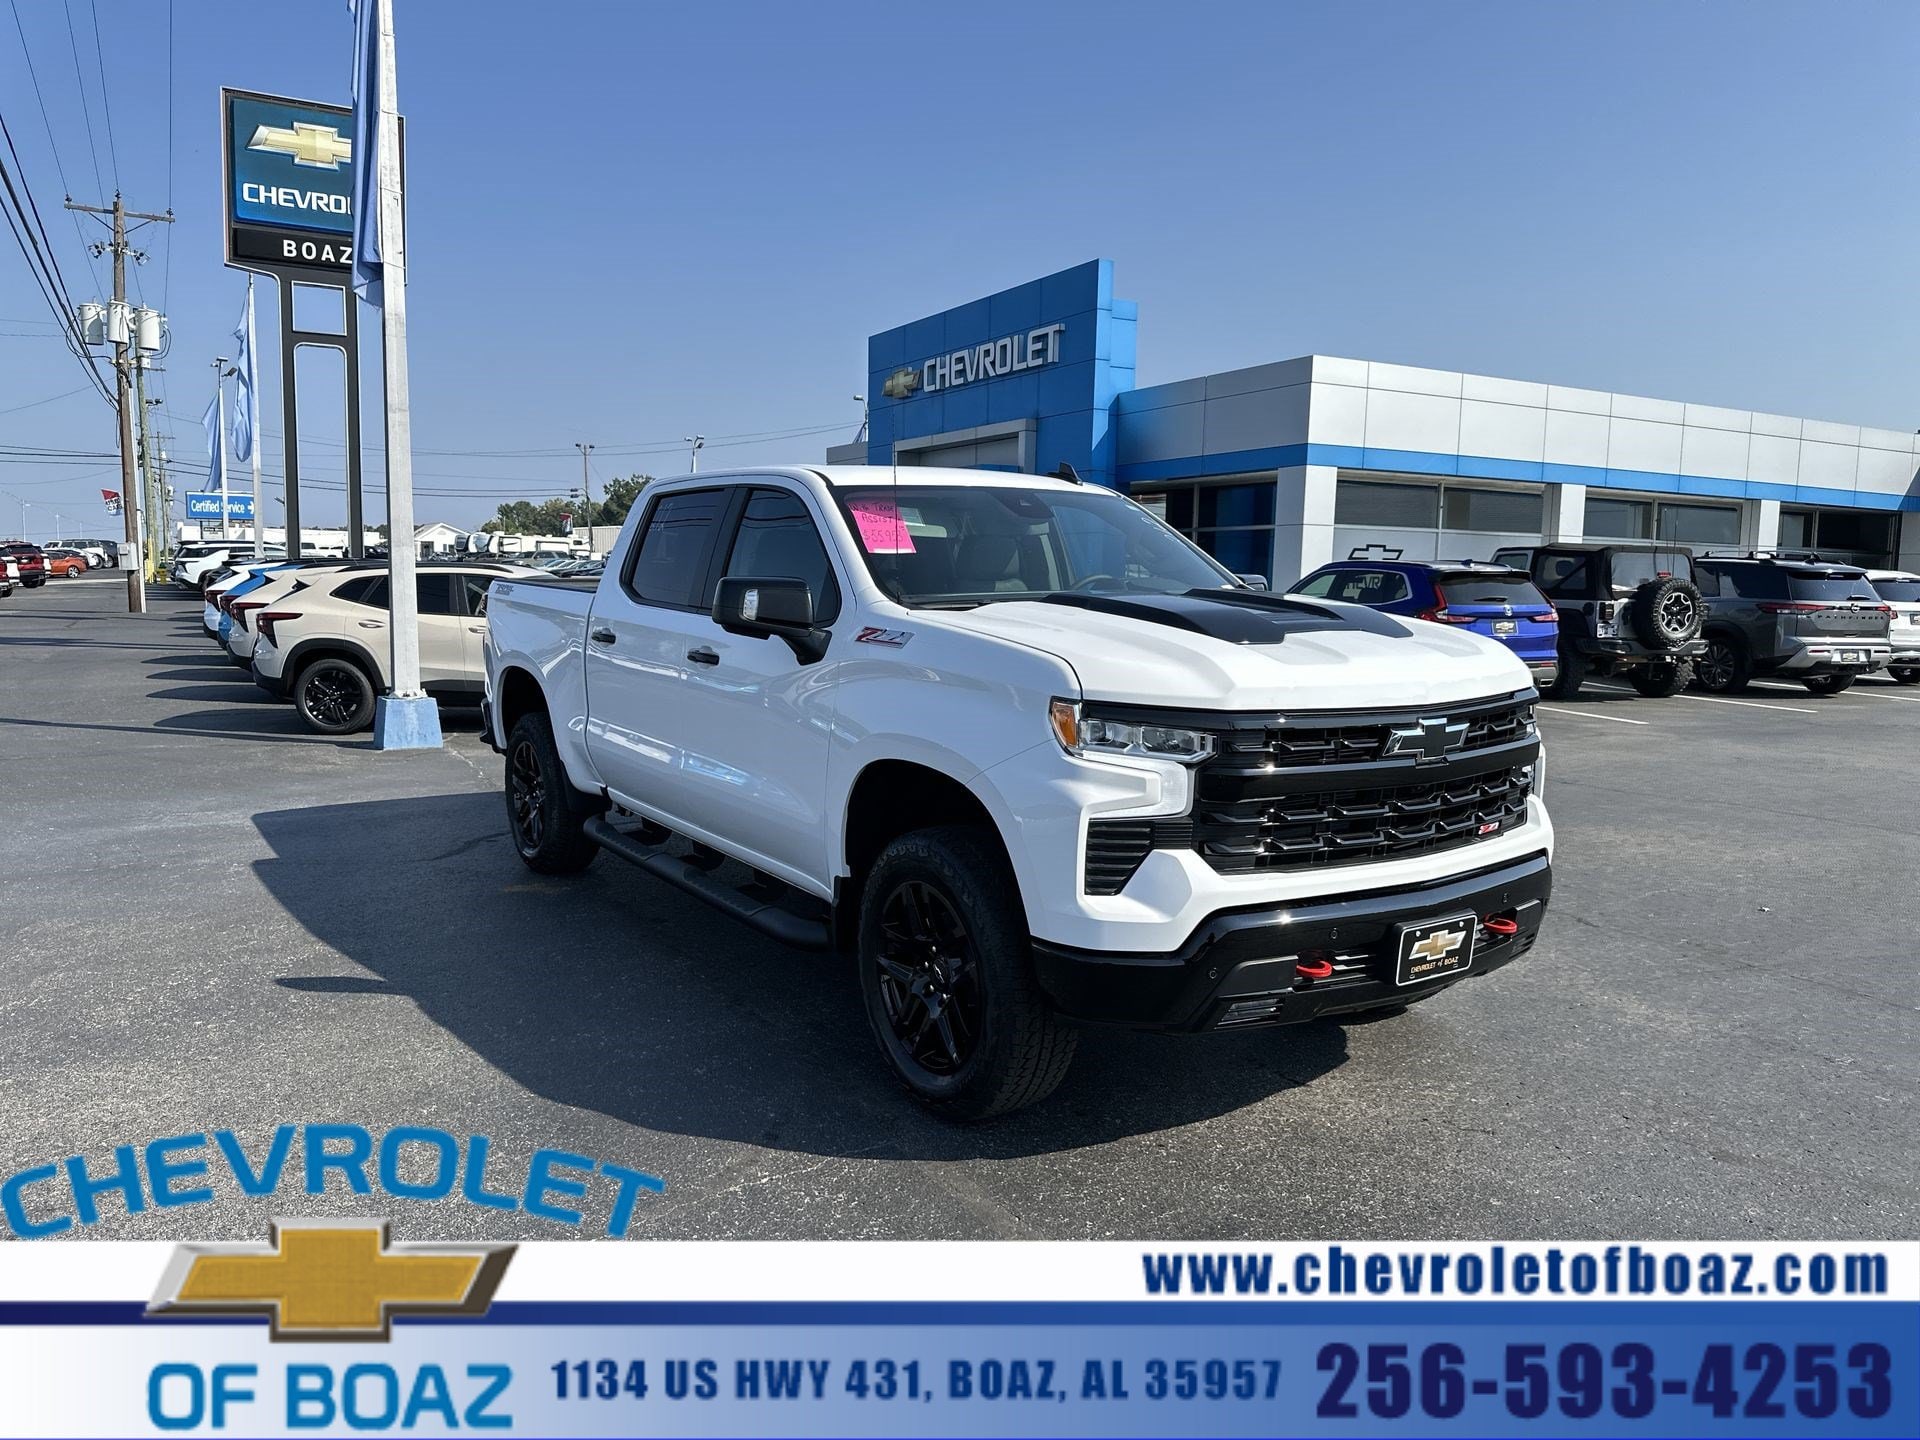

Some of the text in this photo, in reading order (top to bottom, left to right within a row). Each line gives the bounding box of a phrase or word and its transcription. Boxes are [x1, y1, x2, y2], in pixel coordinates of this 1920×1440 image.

[242, 182, 352, 214] CHEVRO
[283, 239, 353, 264] BOAZ
[923, 323, 1066, 393] CHEVROLET
[191, 499, 220, 513] Certified
[1410, 961, 1437, 974] CHEVROLET
